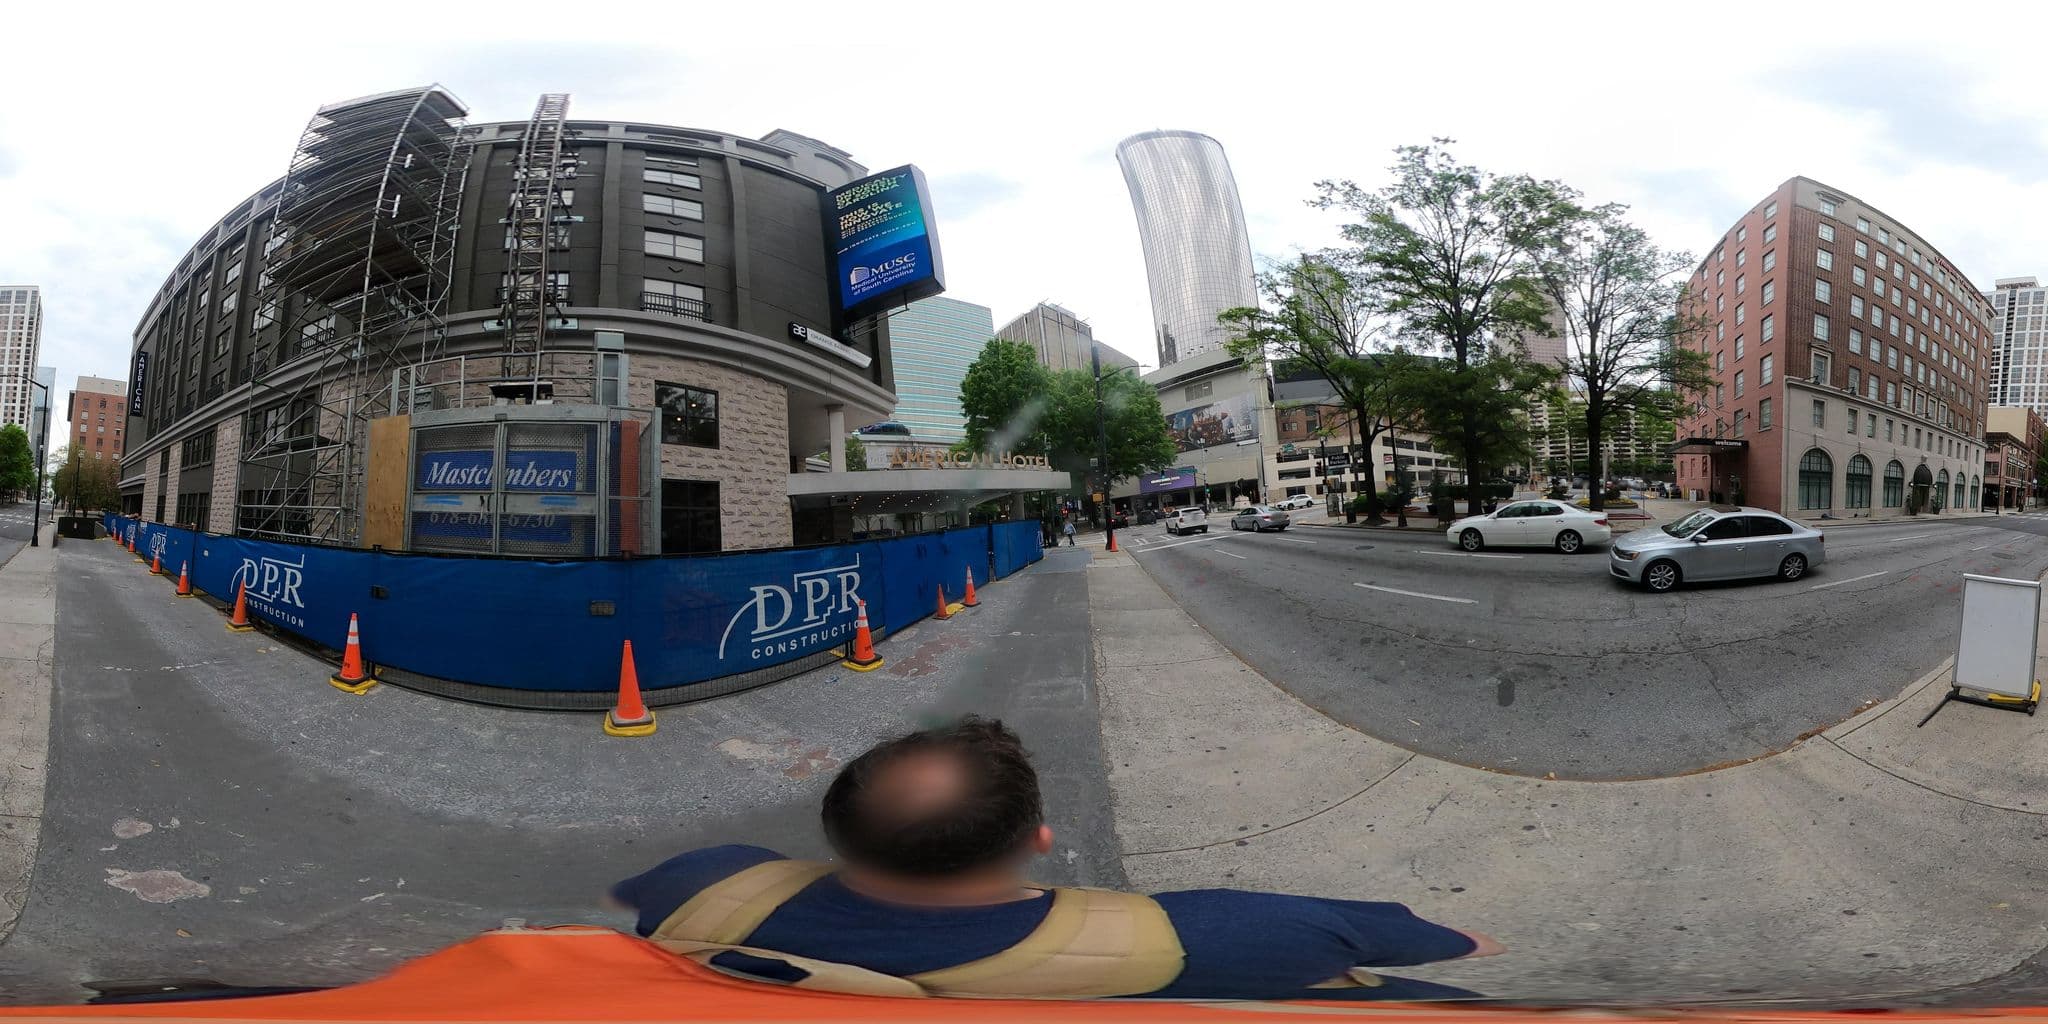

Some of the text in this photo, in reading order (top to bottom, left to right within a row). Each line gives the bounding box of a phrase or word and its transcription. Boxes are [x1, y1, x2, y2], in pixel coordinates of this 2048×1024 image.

[840, 201, 902, 230] INNOVATE
[851, 261, 916, 291] Medical University
[871, 252, 915, 276] MUSC
[861, 280, 882, 293] South
[882, 268, 914, 283] Carolina
[134, 356, 145, 409] AMERICAN
[889, 447, 994, 470] AMERICAN
[1001, 450, 1052, 471] HOTEL
[425, 461, 573, 488] Mastclmbers
[241, 557, 305, 608] DPR
[750, 571, 866, 635] DPR
